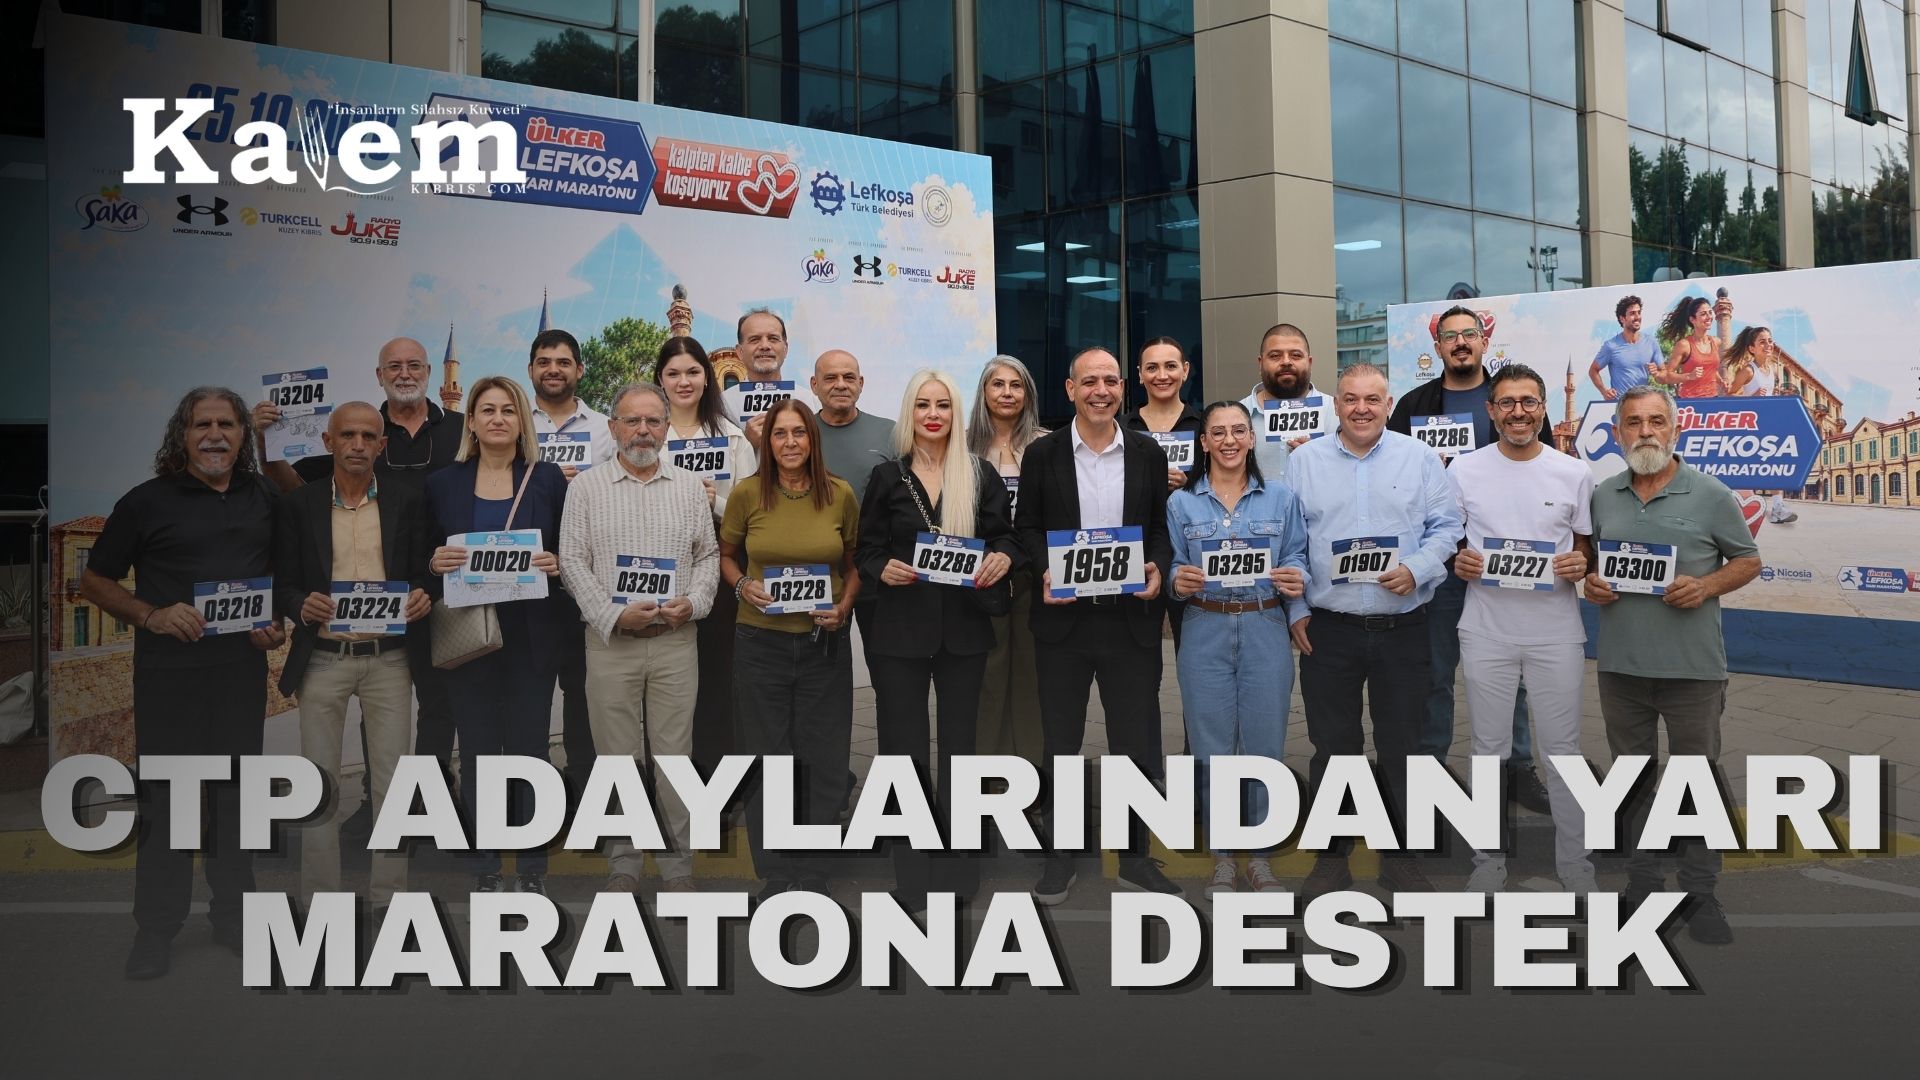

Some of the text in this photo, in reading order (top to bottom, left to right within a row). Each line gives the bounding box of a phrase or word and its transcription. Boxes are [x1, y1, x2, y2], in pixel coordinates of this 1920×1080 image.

[526, 117, 605, 151] ÜLKER
[520, 147, 639, 184] LEFKOŞA
[668, 143, 751, 177] kalpten kalbe
[555, 179, 637, 201] MARATONU
[664, 171, 730, 202] koşuyoruz
[850, 181, 914, 207] Lefkoşa
[260, 212, 322, 227] TURKCELL
[370, 217, 401, 225] RADYO
[851, 203, 914, 218] Türk Belediyesi
[278, 227, 322, 236] KUZEY KIBRIS
[330, 212, 401, 240] JUKE
[898, 266, 932, 278] TURKCELL
[936, 265, 976, 286] JUKE
[269, 383, 325, 407] 03204
[1268, 410, 1319, 432] 03283
[1417, 427, 1469, 448] 03286
[673, 451, 725, 472] 03299
[1701, 463, 1796, 477] MARATONU
[470, 550, 533, 572] 00020
[917, 548, 978, 575] 03288
[1063, 545, 1131, 585] 1958
[1208, 552, 1265, 576] 03295
[1339, 551, 1391, 575] 01907
[1487, 553, 1548, 579] 03227
[1604, 555, 1667, 582] 03300
[1777, 568, 1812, 578] Nicosia
[616, 570, 671, 595] 03290
[770, 579, 826, 602] 03228
[204, 594, 264, 622] 03218
[335, 596, 401, 620] 03224
